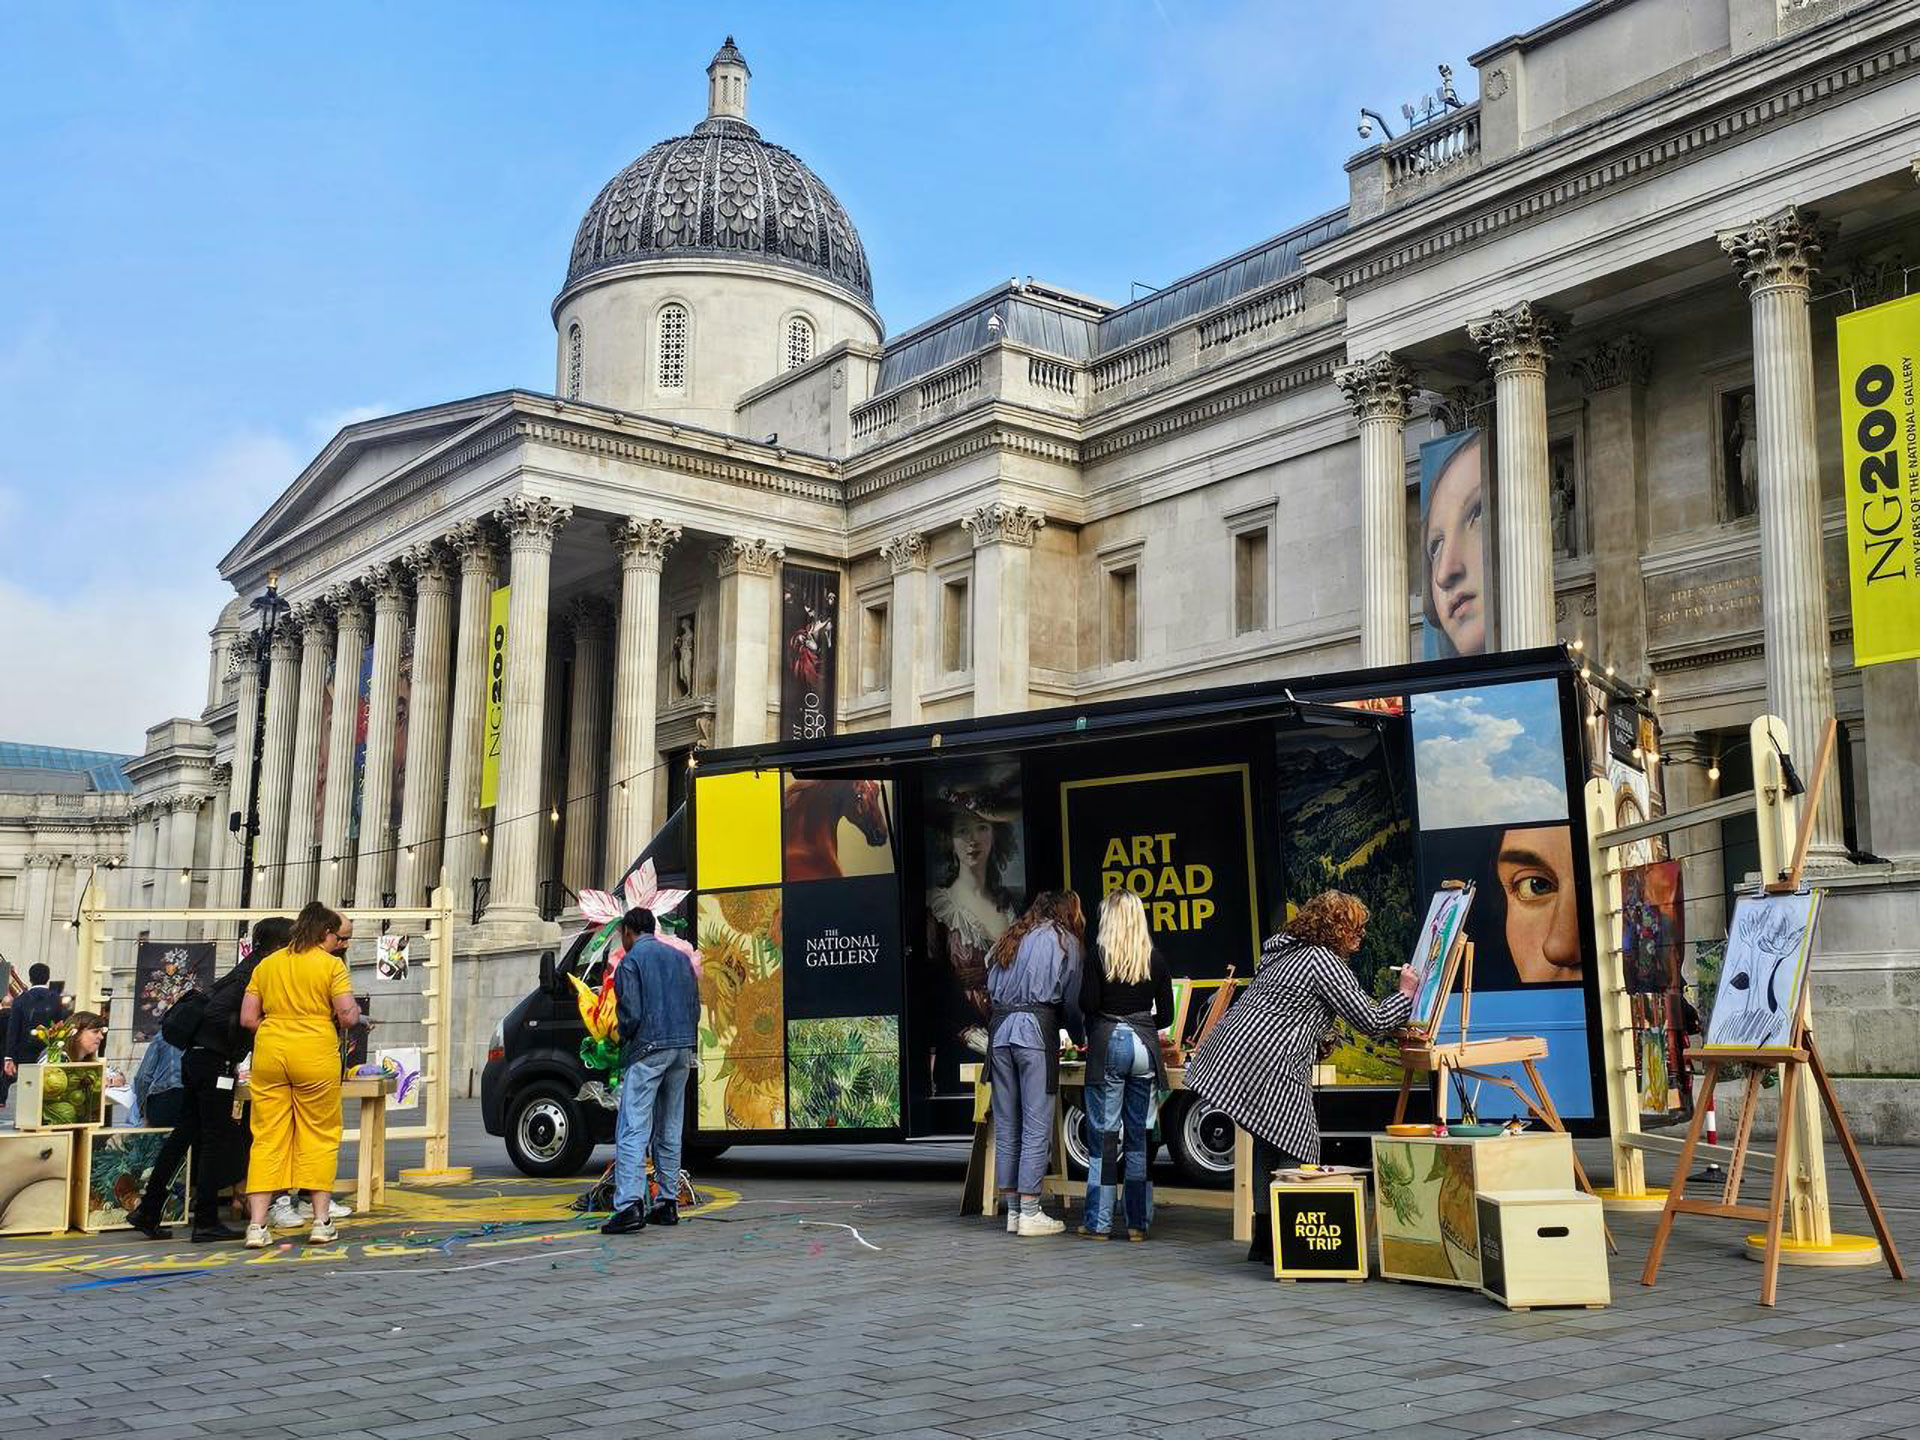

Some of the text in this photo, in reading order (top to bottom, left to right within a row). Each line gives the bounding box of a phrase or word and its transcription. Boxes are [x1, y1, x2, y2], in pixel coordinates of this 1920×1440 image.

[1902, 356, 1913, 406] GALLERY
[1905, 409, 1917, 468] NATIONAL
[1855, 363, 1906, 587] NG200
[1907, 471, 1919, 494] THE
[1910, 497, 1920, 513] OF
[1911, 517, 1920, 555] YEARS
[1102, 833, 1176, 868] ART
[1102, 864, 1213, 900] ROAD
[1143, 899, 1215, 932] RIP
[806, 934, 880, 951] NATIONAL
[806, 948, 879, 967] GALLERY
[1295, 1211, 1326, 1225] ART
[1295, 1225, 1341, 1238] ROAD
[1308, 1238, 1342, 1250] TRIP
